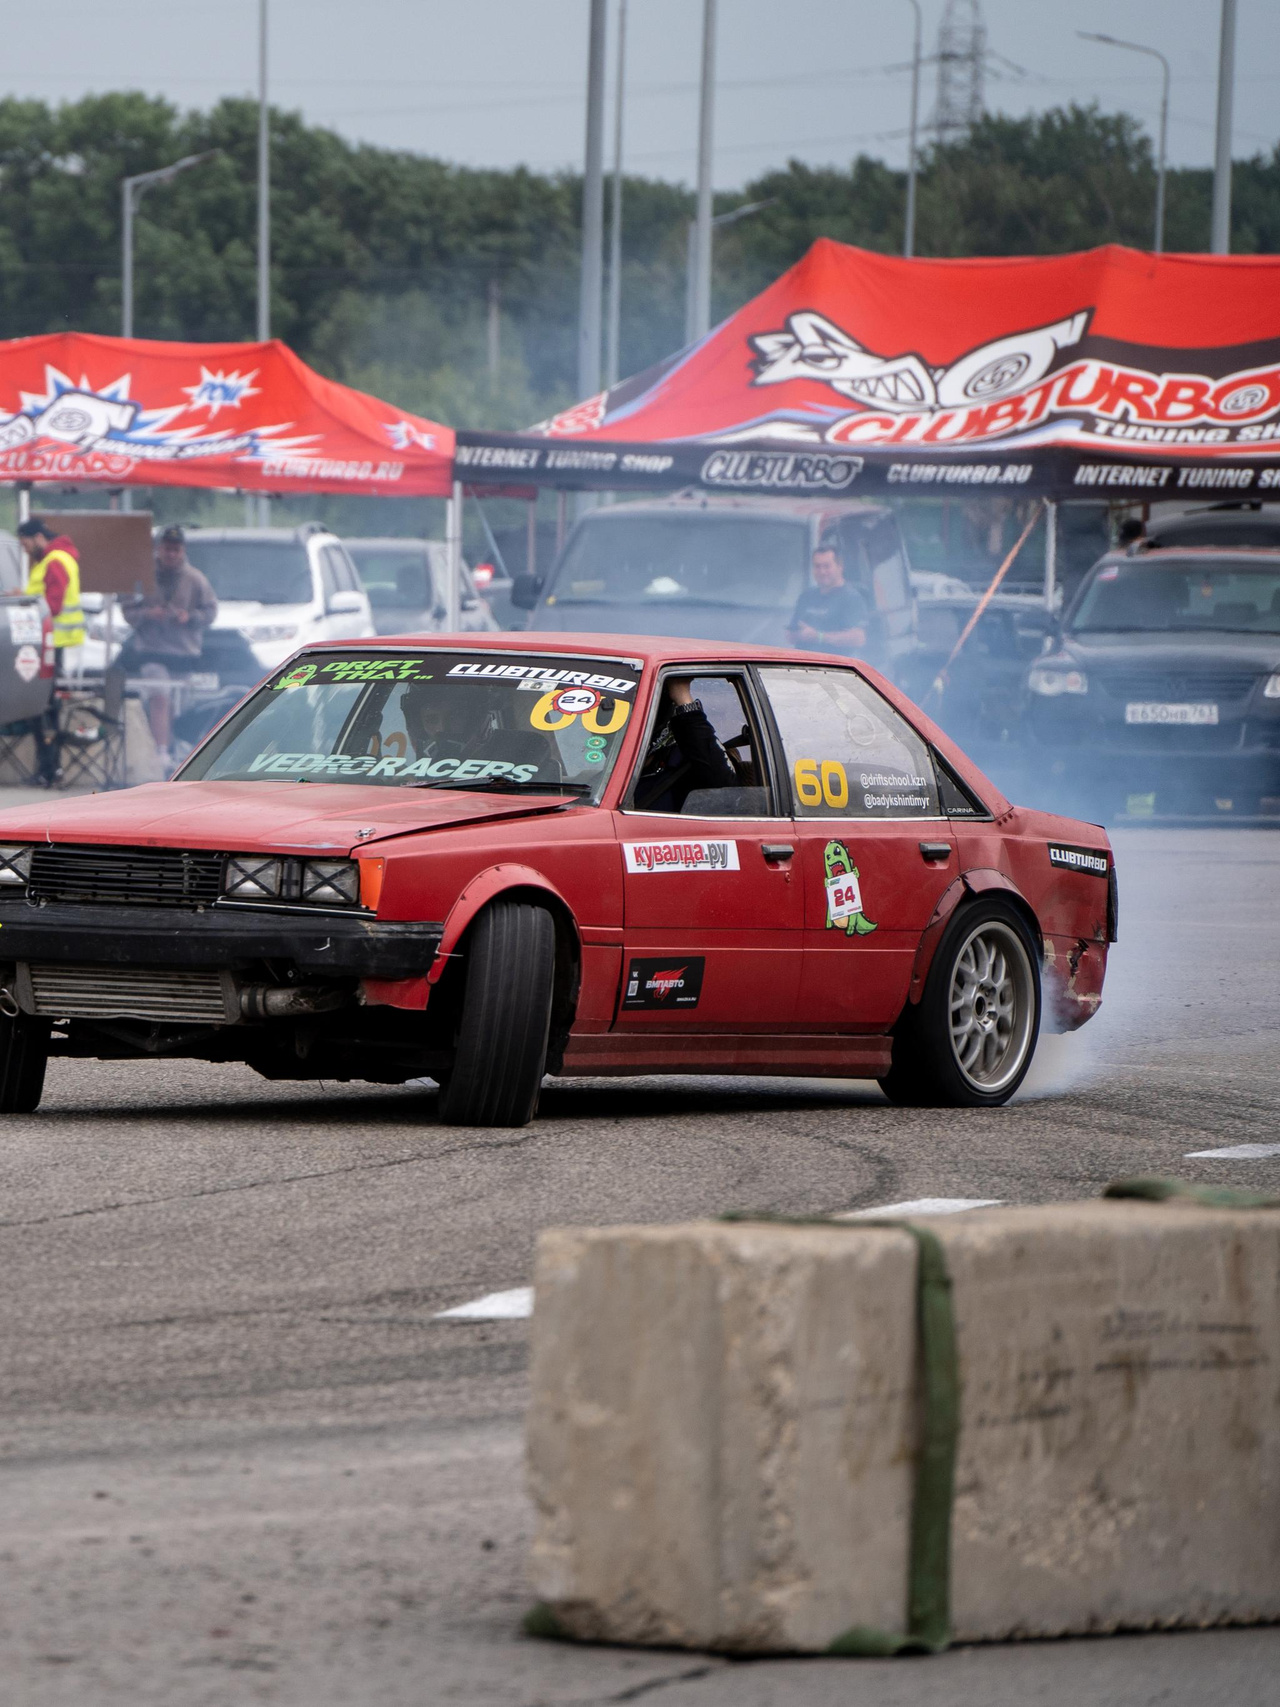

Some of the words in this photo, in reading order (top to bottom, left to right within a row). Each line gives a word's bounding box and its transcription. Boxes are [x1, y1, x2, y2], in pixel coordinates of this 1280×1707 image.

[826, 360, 1280, 444] CLUBTURBO
[1094, 419, 1229, 442] TUNING
[261, 459, 404, 481] CLUBTURBO.RU
[545, 449, 617, 471] TUNING
[621, 453, 674, 473] SHOP
[701, 450, 864, 489] CLUBTURBO
[886, 463, 1032, 484] CLUBTURBO.RU
[1073, 464, 1173, 487] INTERNET
[1176, 467, 1255, 488] TUNING
[320, 660, 424, 672] DRIFT
[447, 663, 637, 692] CLUBTURBO
[561, 695, 593, 705] 24
[794, 758, 849, 808] 60
[860, 773, 927, 789] @driftschool.kzn
[864, 794, 930, 809] @badykshintimyr
[633, 843, 728, 870] кувалда.ру
[1050, 848, 1107, 871] CLUBTURBO
[833, 885, 856, 907] 24
[645, 980, 685, 989] ВМПАВТО
